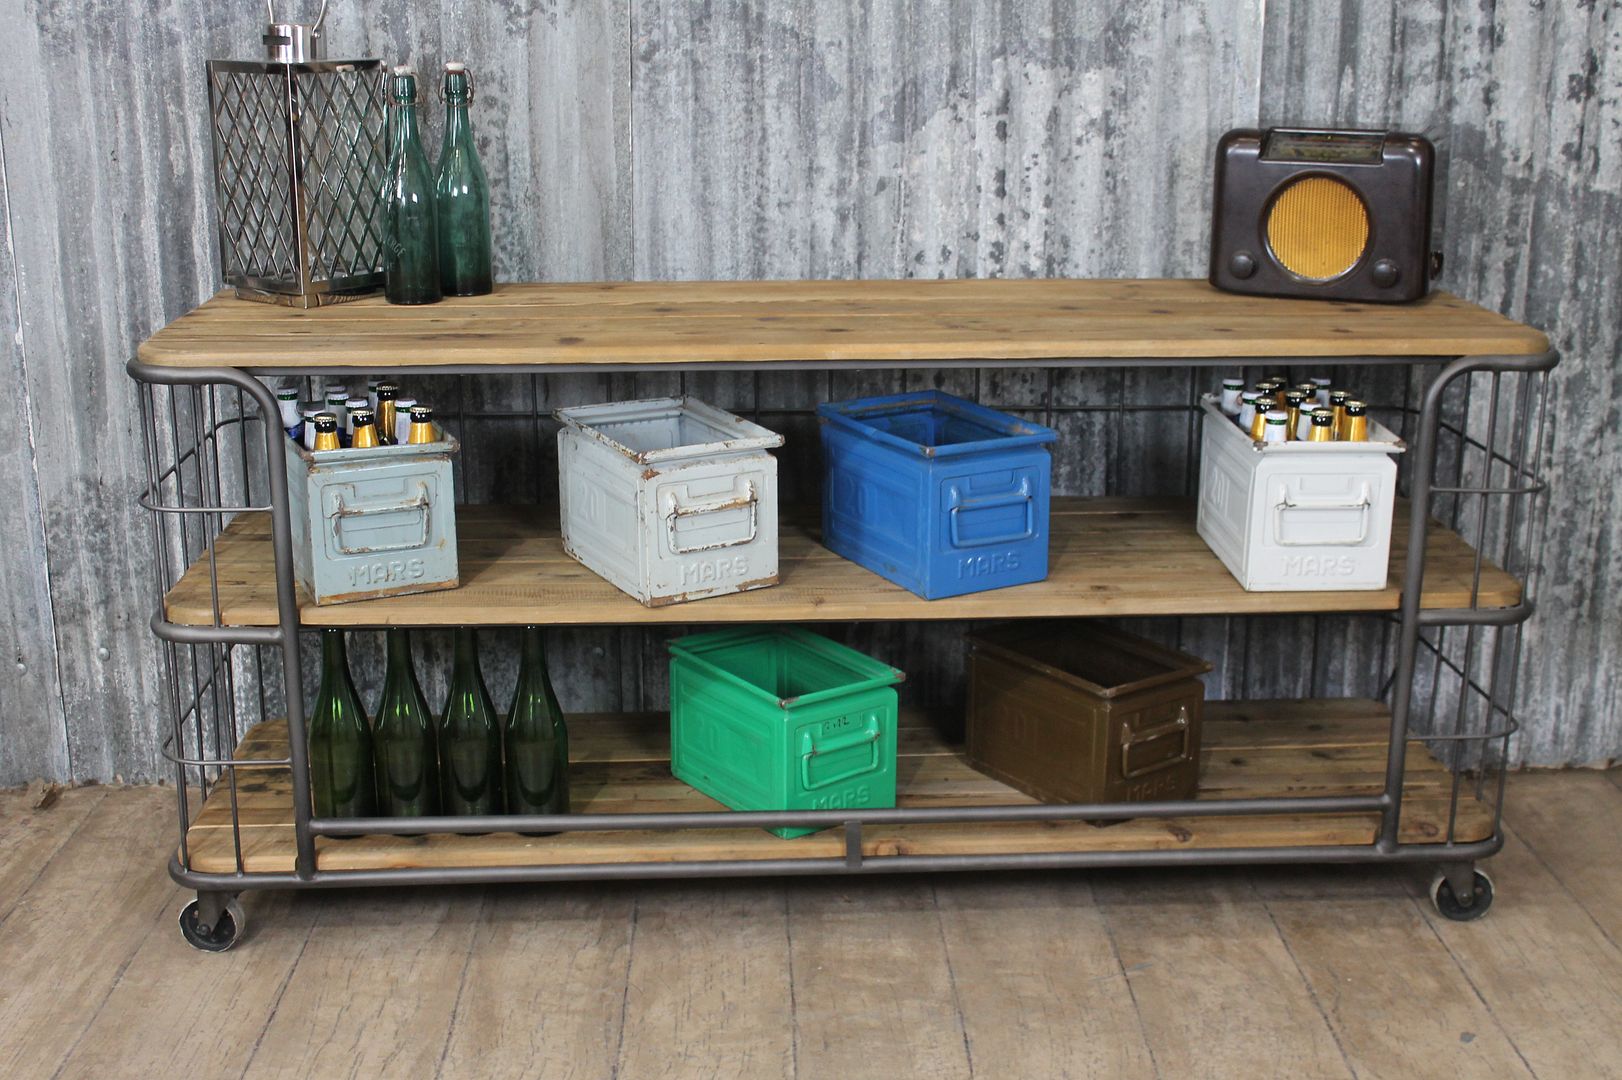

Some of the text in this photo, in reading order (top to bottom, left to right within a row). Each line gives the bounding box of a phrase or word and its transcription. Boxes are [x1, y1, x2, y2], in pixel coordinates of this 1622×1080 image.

[349, 559, 424, 587] MARS
[680, 557, 750, 586] MARS
[958, 552, 1020, 579] MARS
[1281, 555, 1356, 577] MARS
[811, 784, 870, 810] MARS
